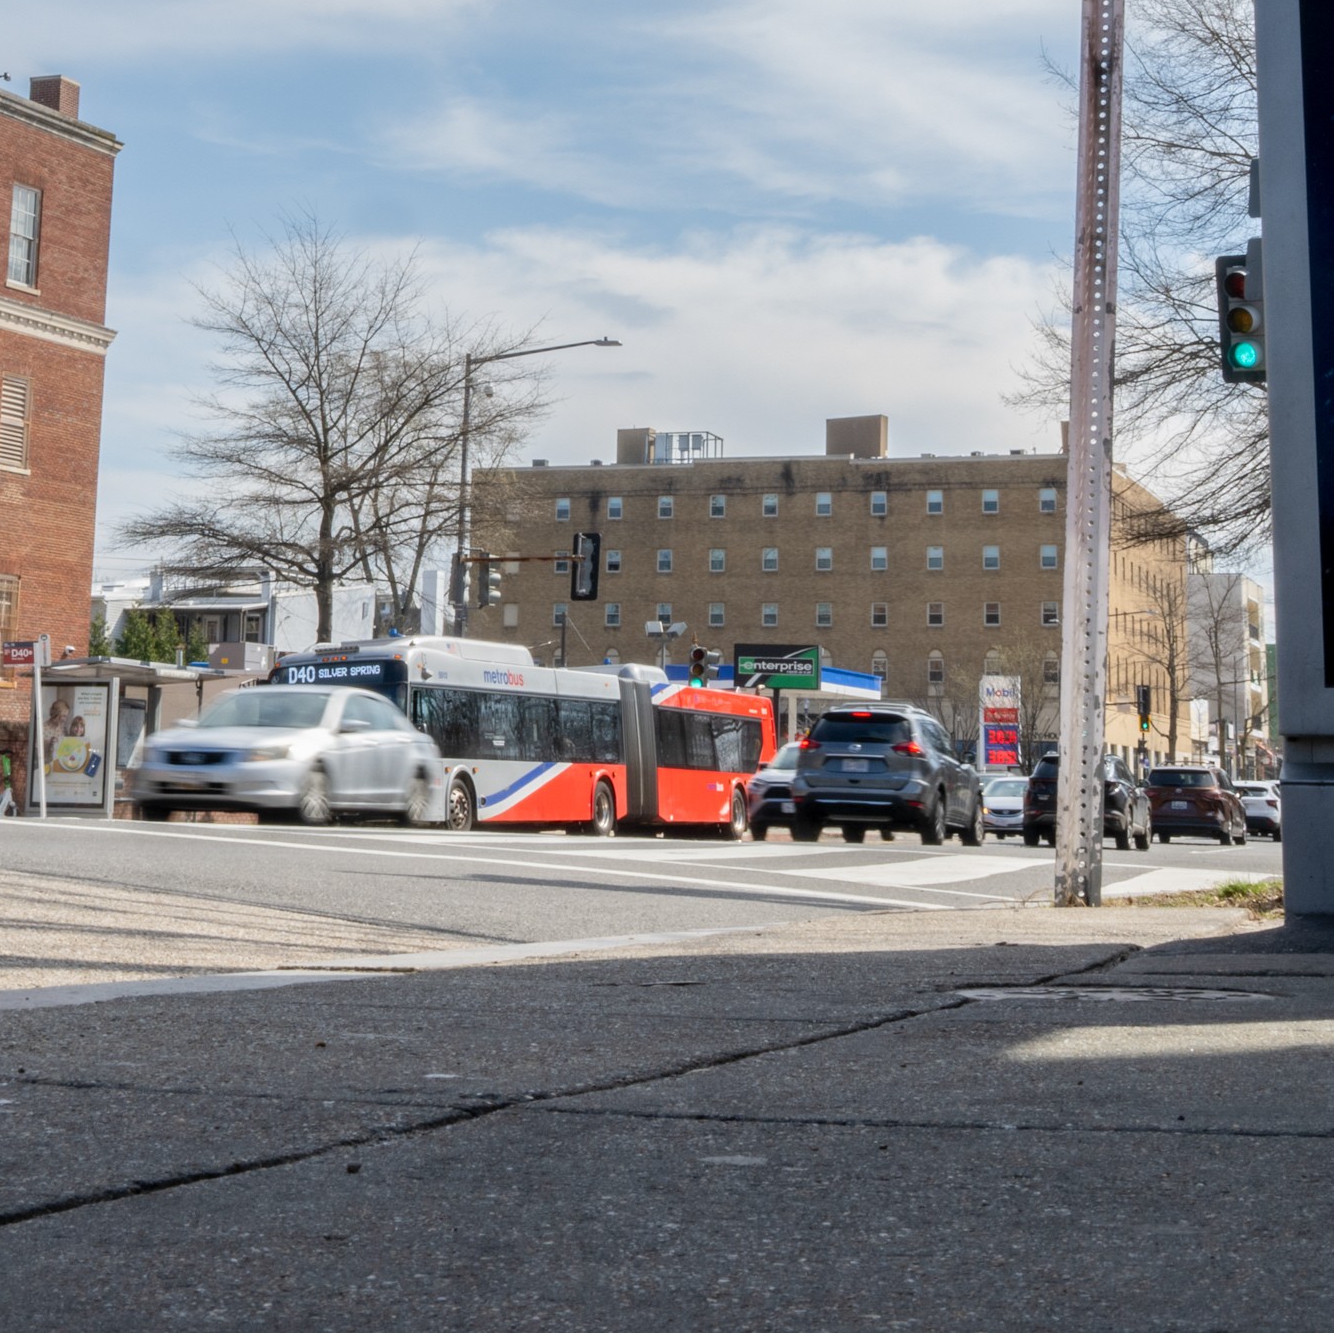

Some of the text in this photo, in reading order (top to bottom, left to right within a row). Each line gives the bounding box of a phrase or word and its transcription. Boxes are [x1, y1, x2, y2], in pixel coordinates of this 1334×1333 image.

[11, 648, 29, 658] D40
[742, 661, 812, 672] enterprise
[288, 664, 381, 684] D40 SILVER SPRING
[483, 669, 524, 687] metrobus
[986, 687, 1016, 697] Mobil
